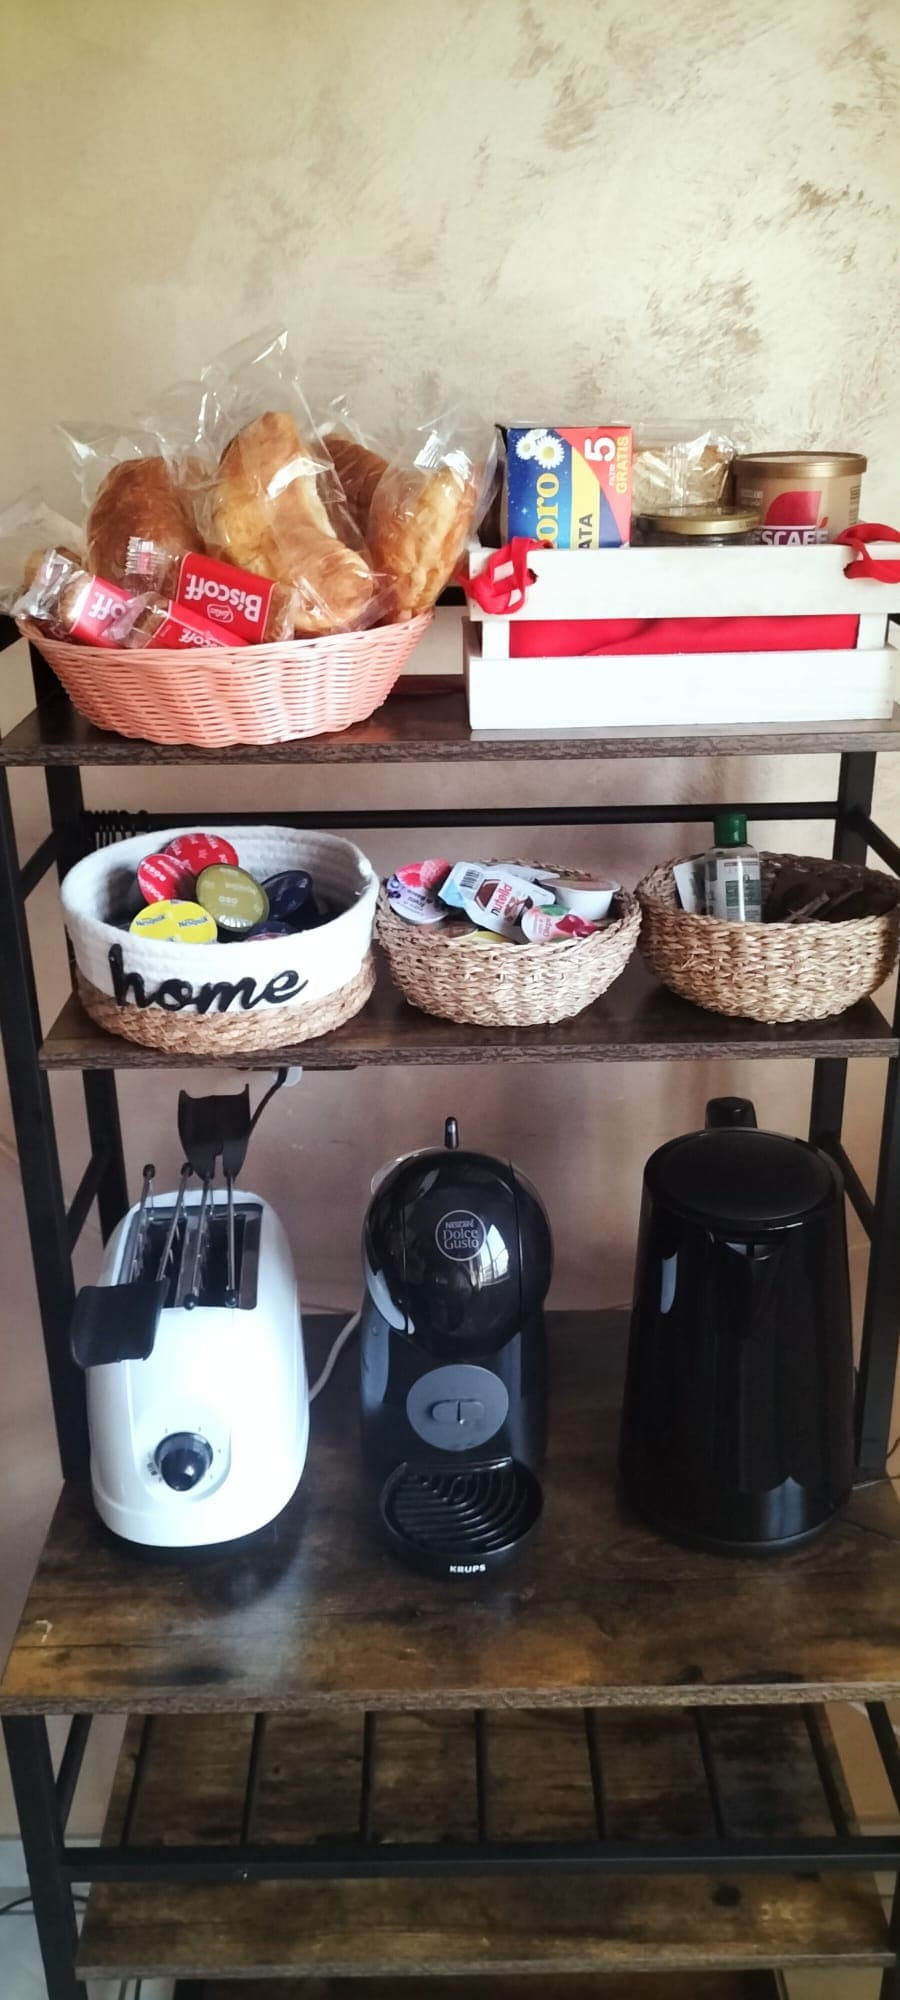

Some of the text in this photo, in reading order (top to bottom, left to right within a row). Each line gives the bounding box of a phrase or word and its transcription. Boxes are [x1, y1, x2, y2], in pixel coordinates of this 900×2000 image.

[584, 437, 616, 462] 5
[615, 436, 629, 494] GRATIS
[536, 473, 559, 542] oro
[184, 574, 262, 623] Biscoff
[490, 883, 513, 917] nutella
[108, 943, 309, 1014] home
[443, 1228, 479, 1240] Dolce
[443, 1238, 480, 1250] Gusto
[449, 1563, 487, 1573] KRUPS
